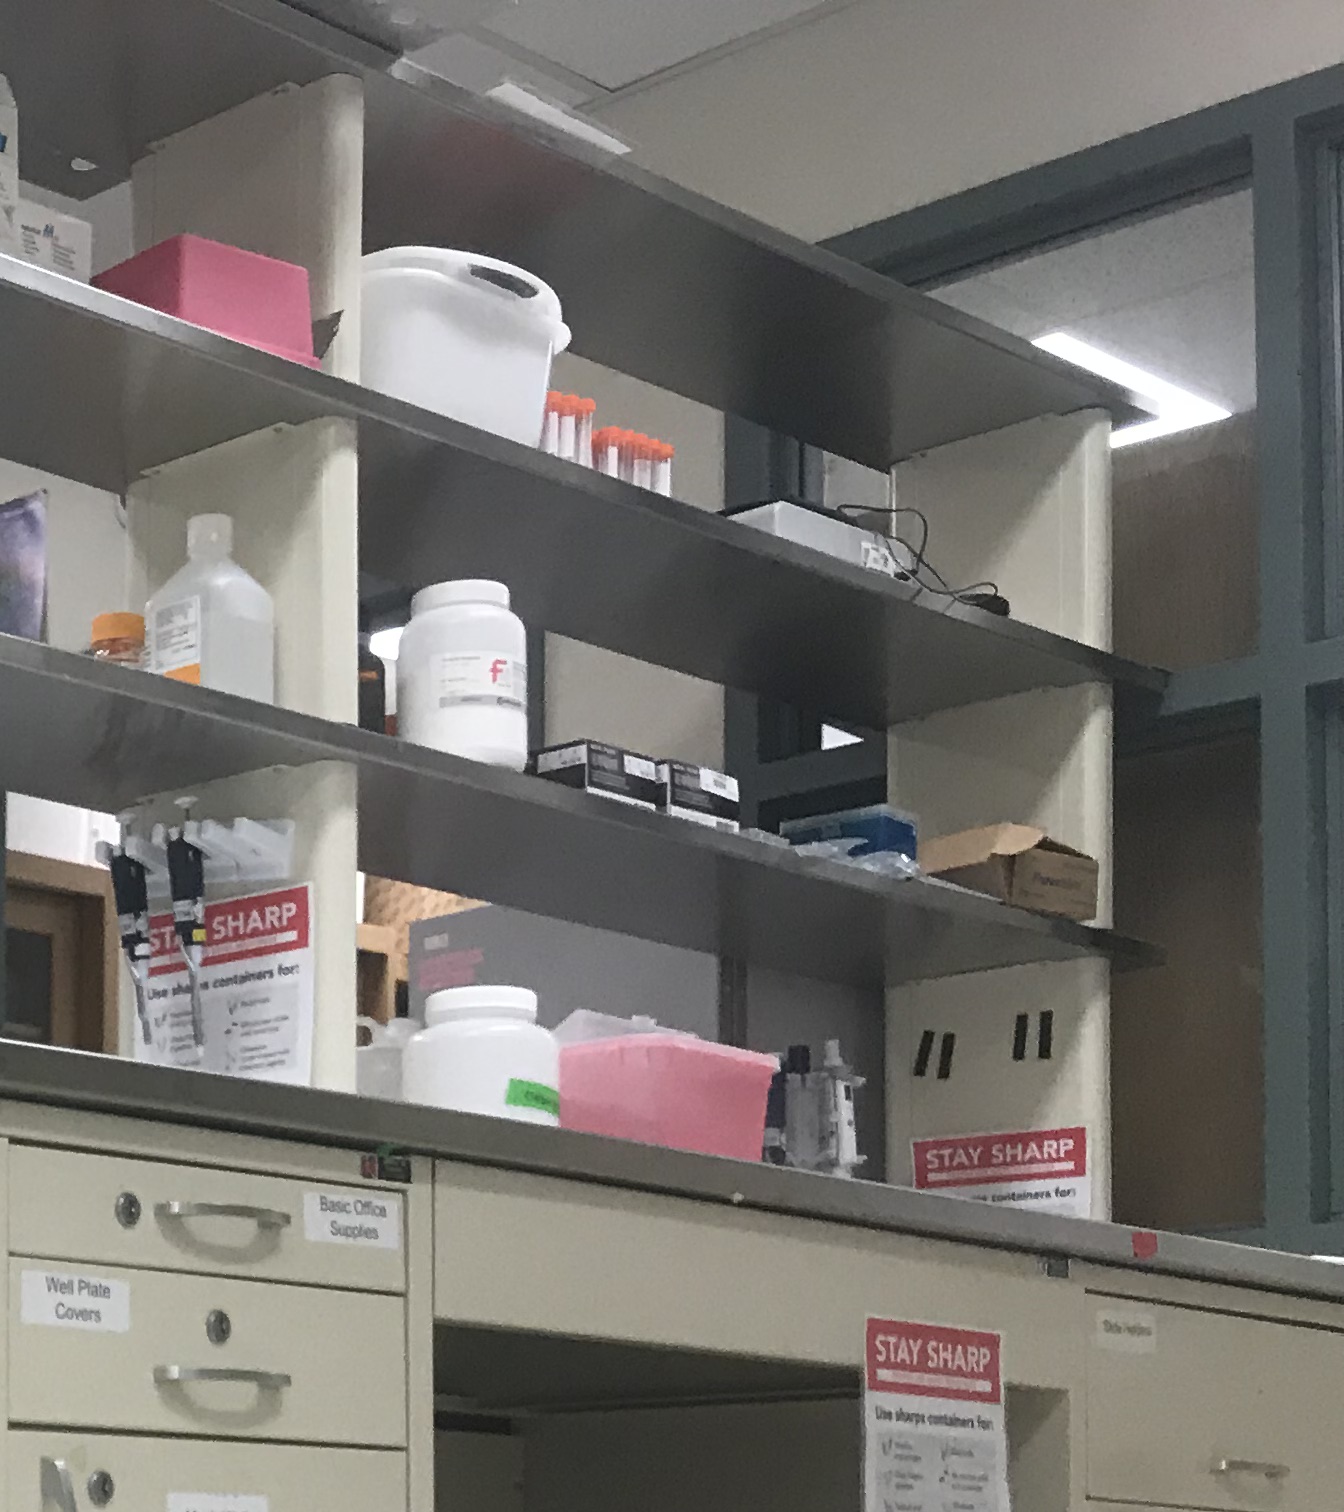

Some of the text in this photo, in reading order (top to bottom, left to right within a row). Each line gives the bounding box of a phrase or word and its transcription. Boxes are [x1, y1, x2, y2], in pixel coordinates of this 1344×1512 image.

[212, 901, 298, 941] SHARP
[925, 1137, 1075, 1170] STAY SHARP
[319, 1195, 387, 1218] Basic Office
[330, 1220, 379, 1240] Supplies
[45, 1275, 111, 1299] Well Plate
[55, 1301, 102, 1323] Covers
[875, 1334, 992, 1373] STAY SHARP
